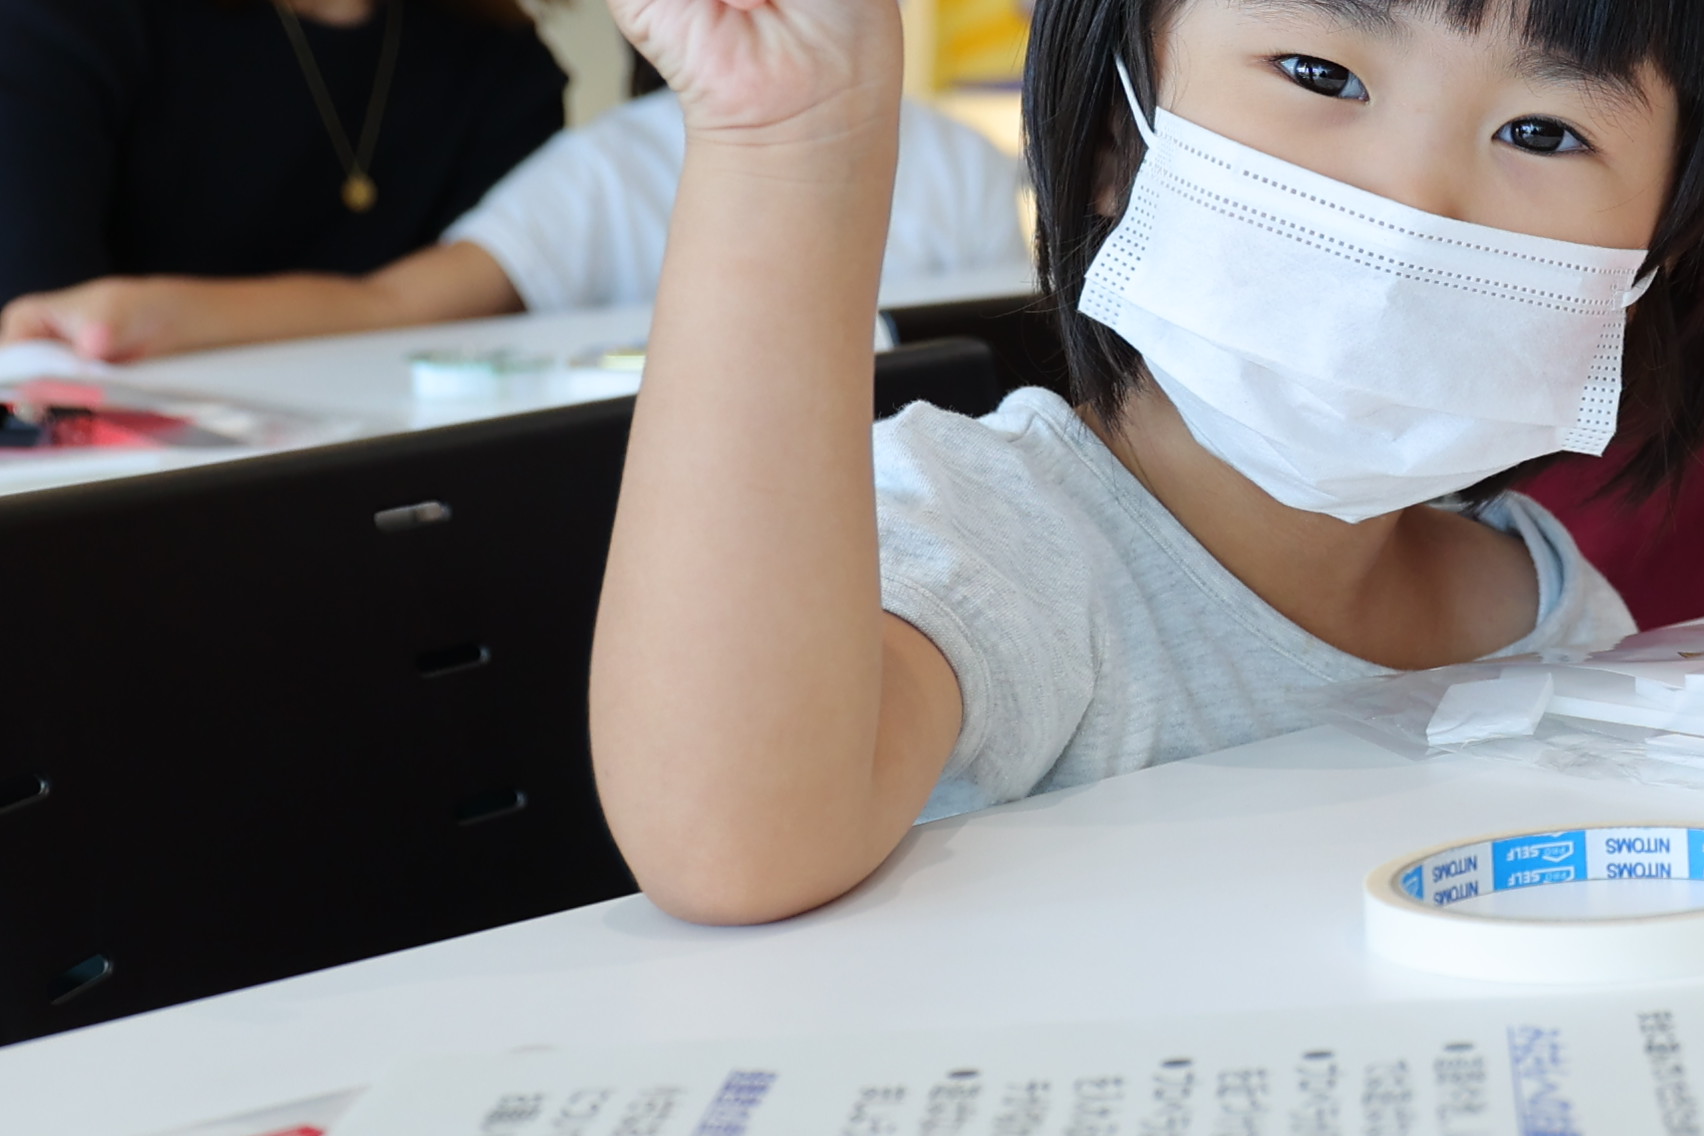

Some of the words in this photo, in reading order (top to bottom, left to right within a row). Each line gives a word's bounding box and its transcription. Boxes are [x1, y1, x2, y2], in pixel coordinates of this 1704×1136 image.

[1506, 844, 1539, 862] SELF
[1605, 837, 1671, 855] NITOMS
[1431, 855, 1478, 883] NITOMS
[1606, 862, 1672, 879] NITOMS
[1507, 871, 1541, 886] SELF
[1433, 880, 1480, 906] NITOMS
